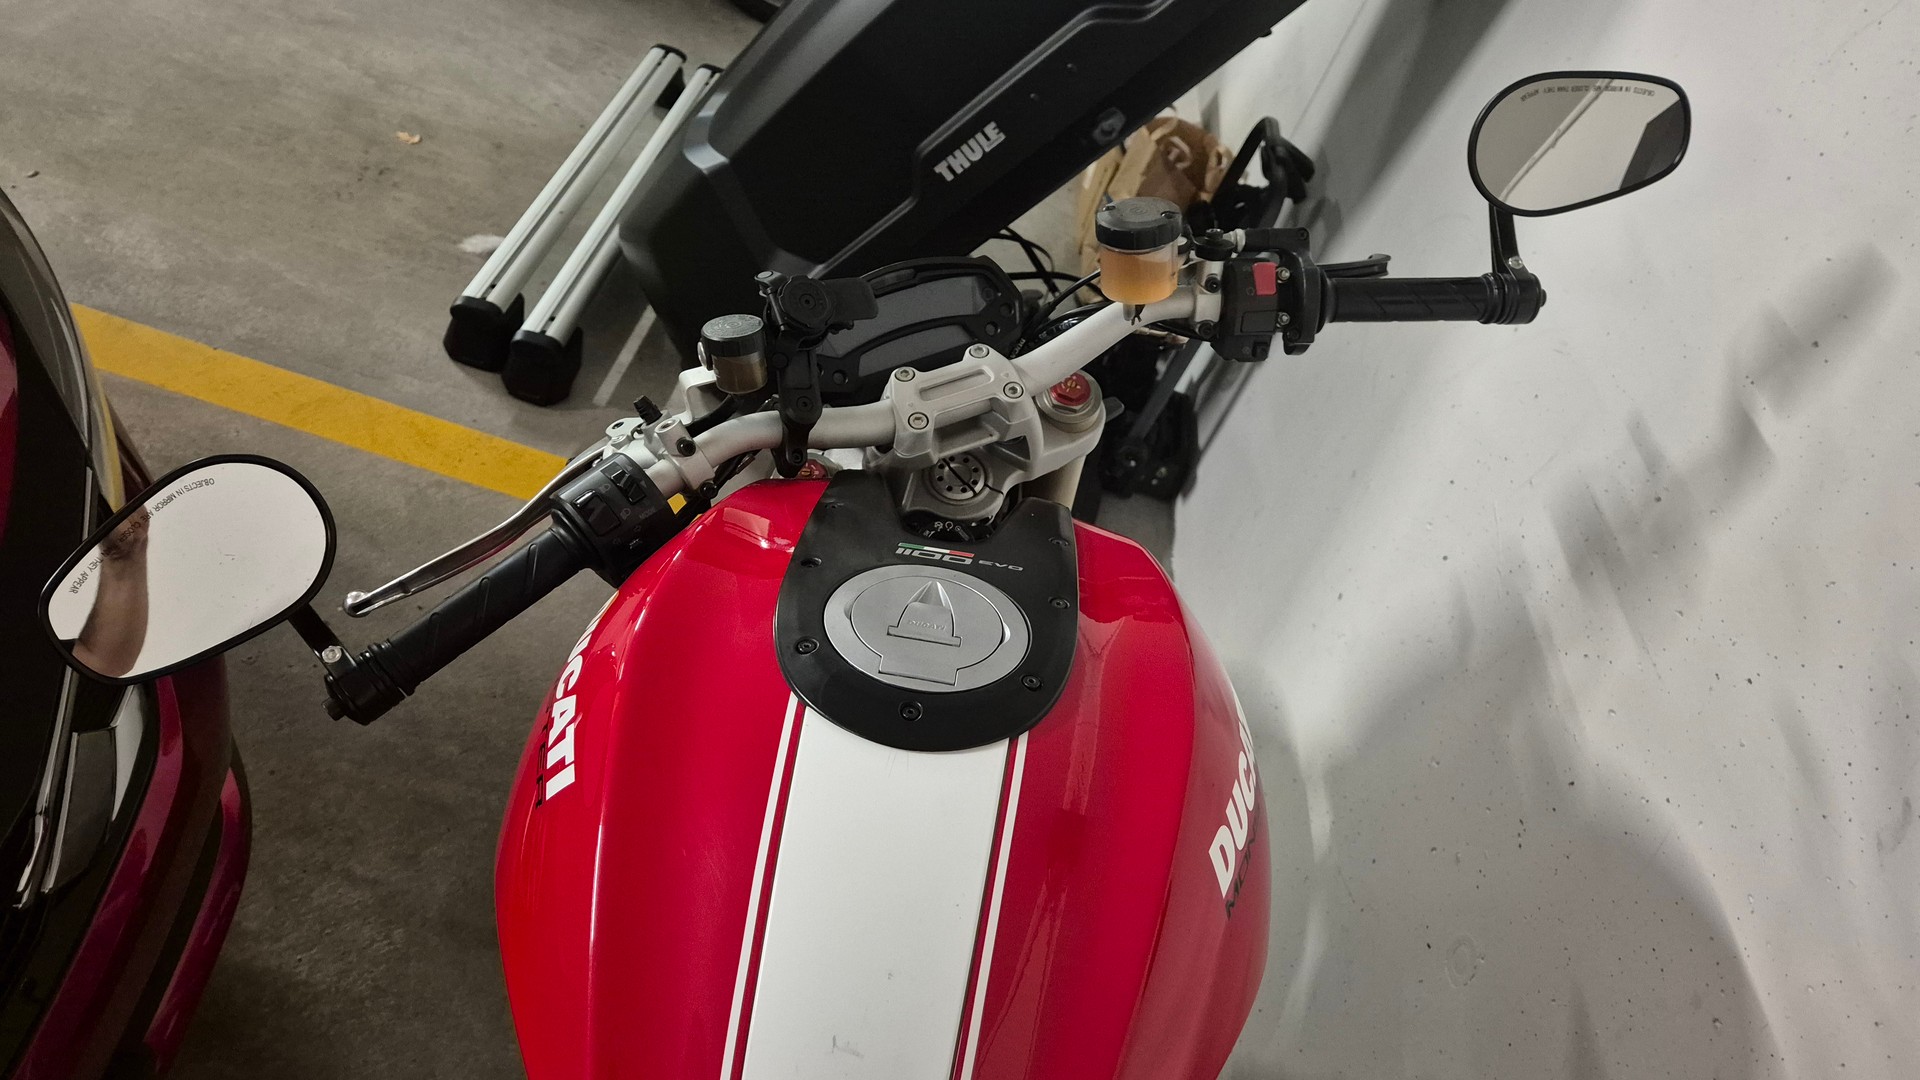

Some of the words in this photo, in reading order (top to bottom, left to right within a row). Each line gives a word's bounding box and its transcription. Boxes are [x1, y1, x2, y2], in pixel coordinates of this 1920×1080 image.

[933, 121, 1006, 181] THULE
[176, 489, 185, 498] IN
[185, 477, 215, 492] OBJECTS
[154, 493, 177, 512] MIRROR
[88, 556, 104, 573] THEY
[895, 547, 974, 565] 1100
[978, 560, 1024, 572] EVO
[69, 571, 90, 594] APPEAR
